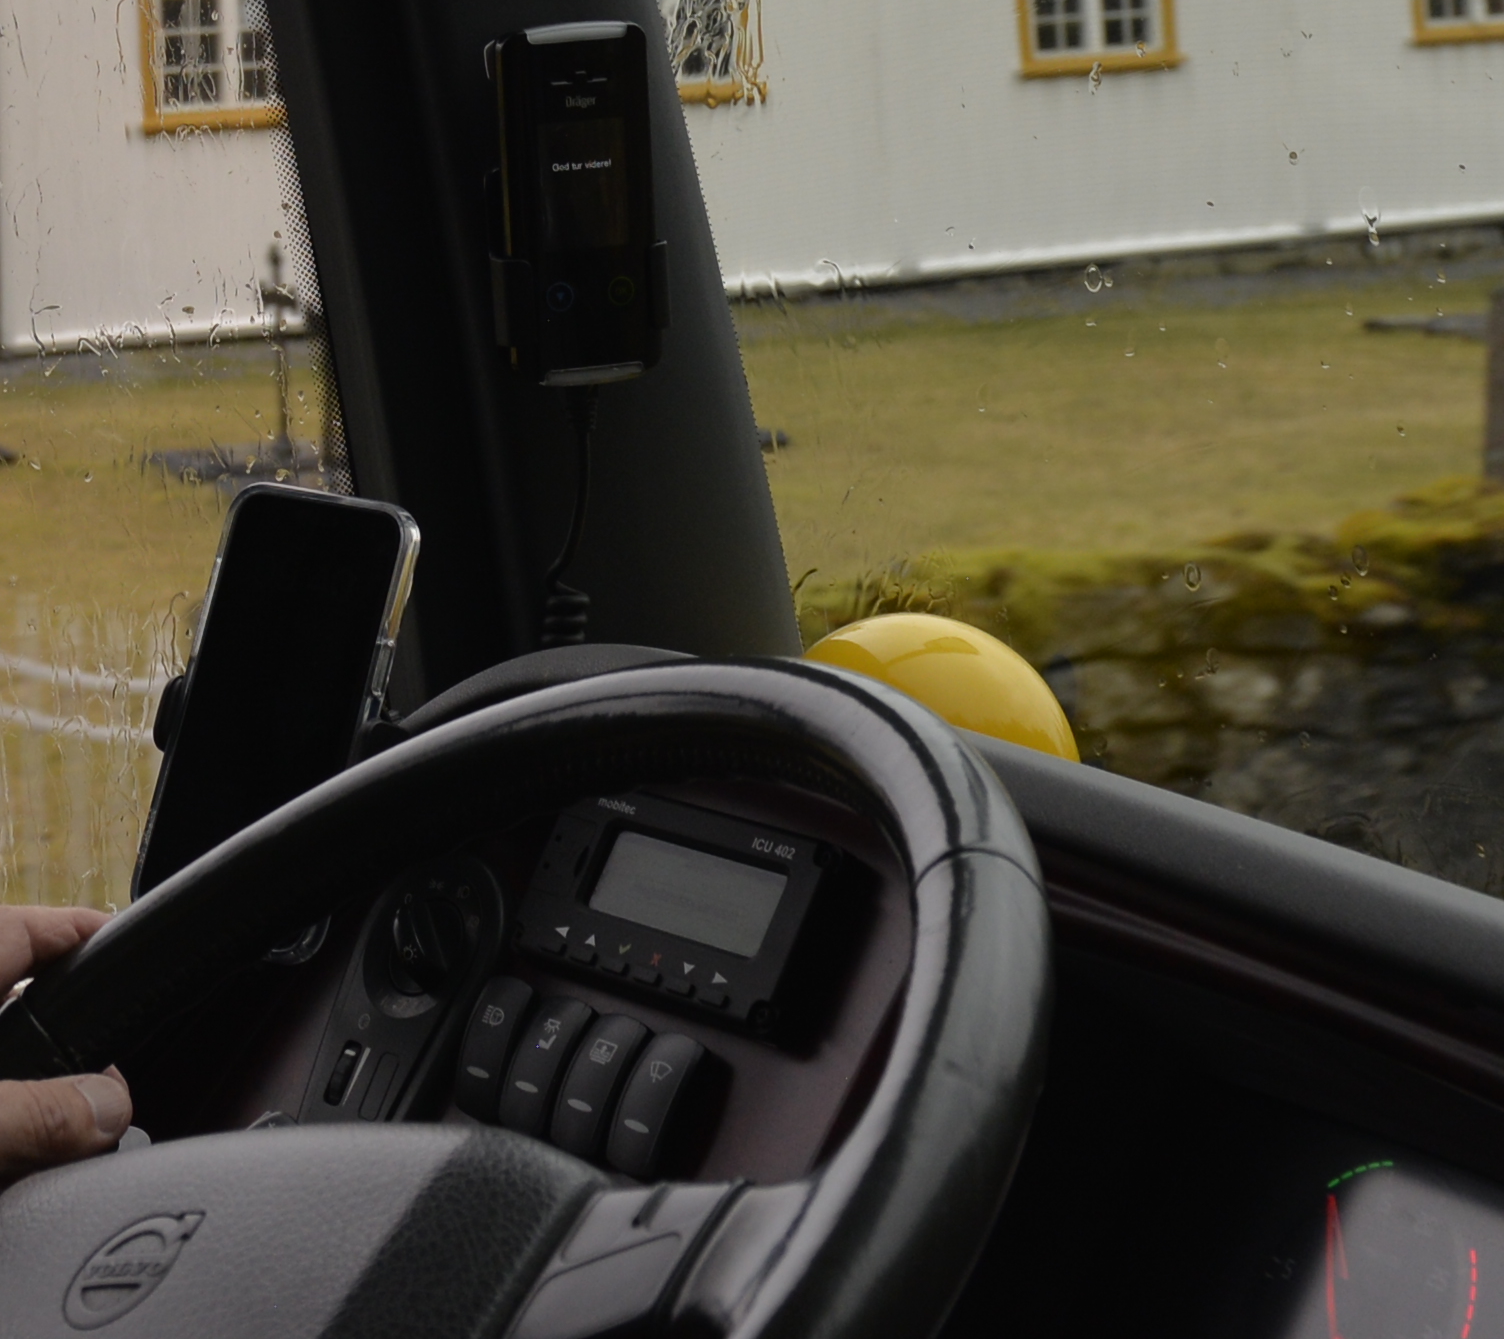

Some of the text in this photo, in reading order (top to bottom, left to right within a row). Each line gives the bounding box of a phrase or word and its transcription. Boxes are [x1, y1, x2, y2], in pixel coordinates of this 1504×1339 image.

[565, 95, 597, 109] Dräger
[597, 797, 637, 815] mobitec
[751, 837, 796, 861] ICU 402
